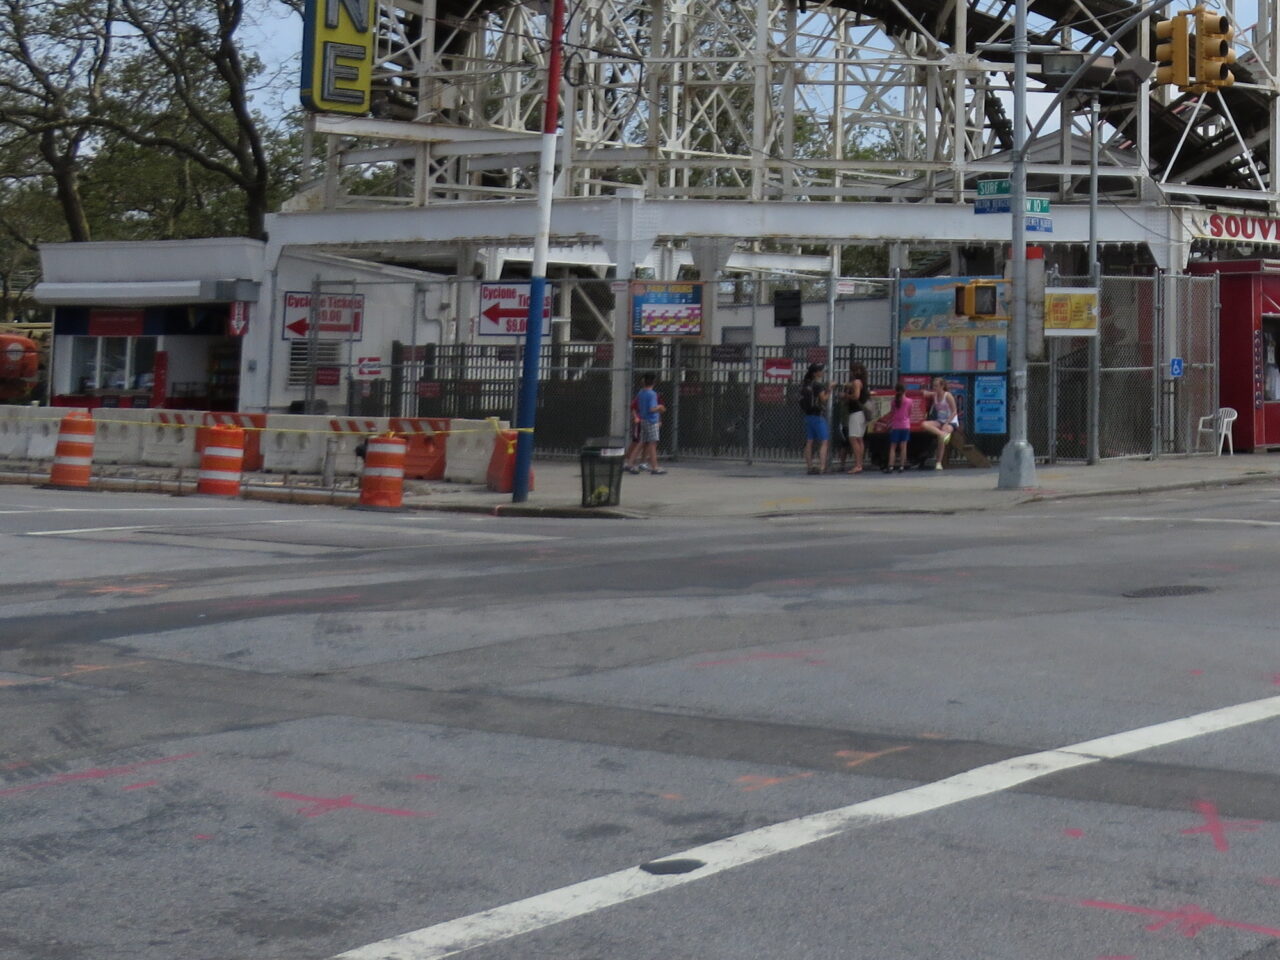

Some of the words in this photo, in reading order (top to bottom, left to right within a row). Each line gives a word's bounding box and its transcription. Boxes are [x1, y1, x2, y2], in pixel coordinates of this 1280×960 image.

[980, 182, 999, 195] SURF
[1033, 199, 1041, 212] 10
[482, 286, 517, 300] Cyclone
